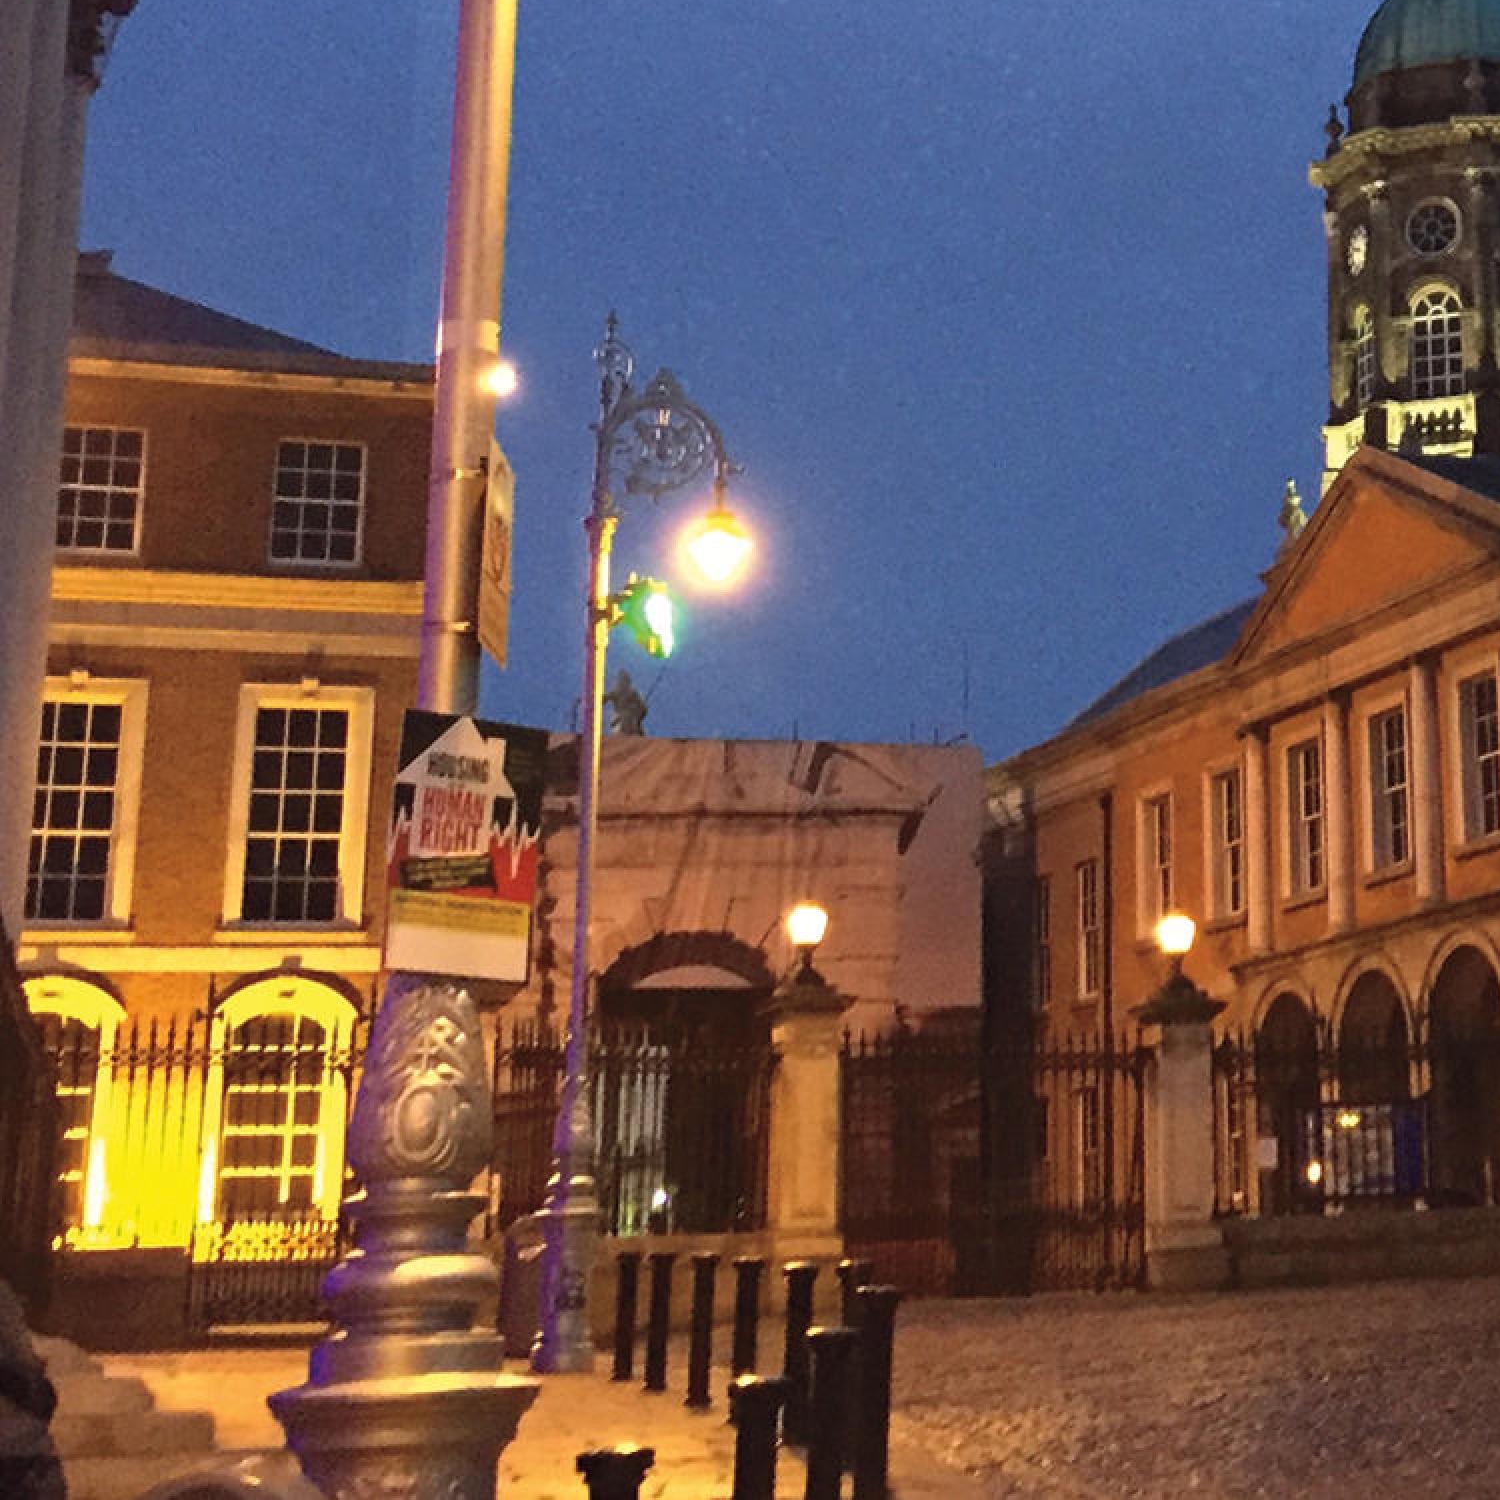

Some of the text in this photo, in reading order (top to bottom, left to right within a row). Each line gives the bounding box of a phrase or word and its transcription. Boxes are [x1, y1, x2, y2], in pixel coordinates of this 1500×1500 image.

[428, 752, 489, 784] HOUSING
[423, 787, 486, 822] HUMAN
[420, 819, 481, 851] RIGHT
